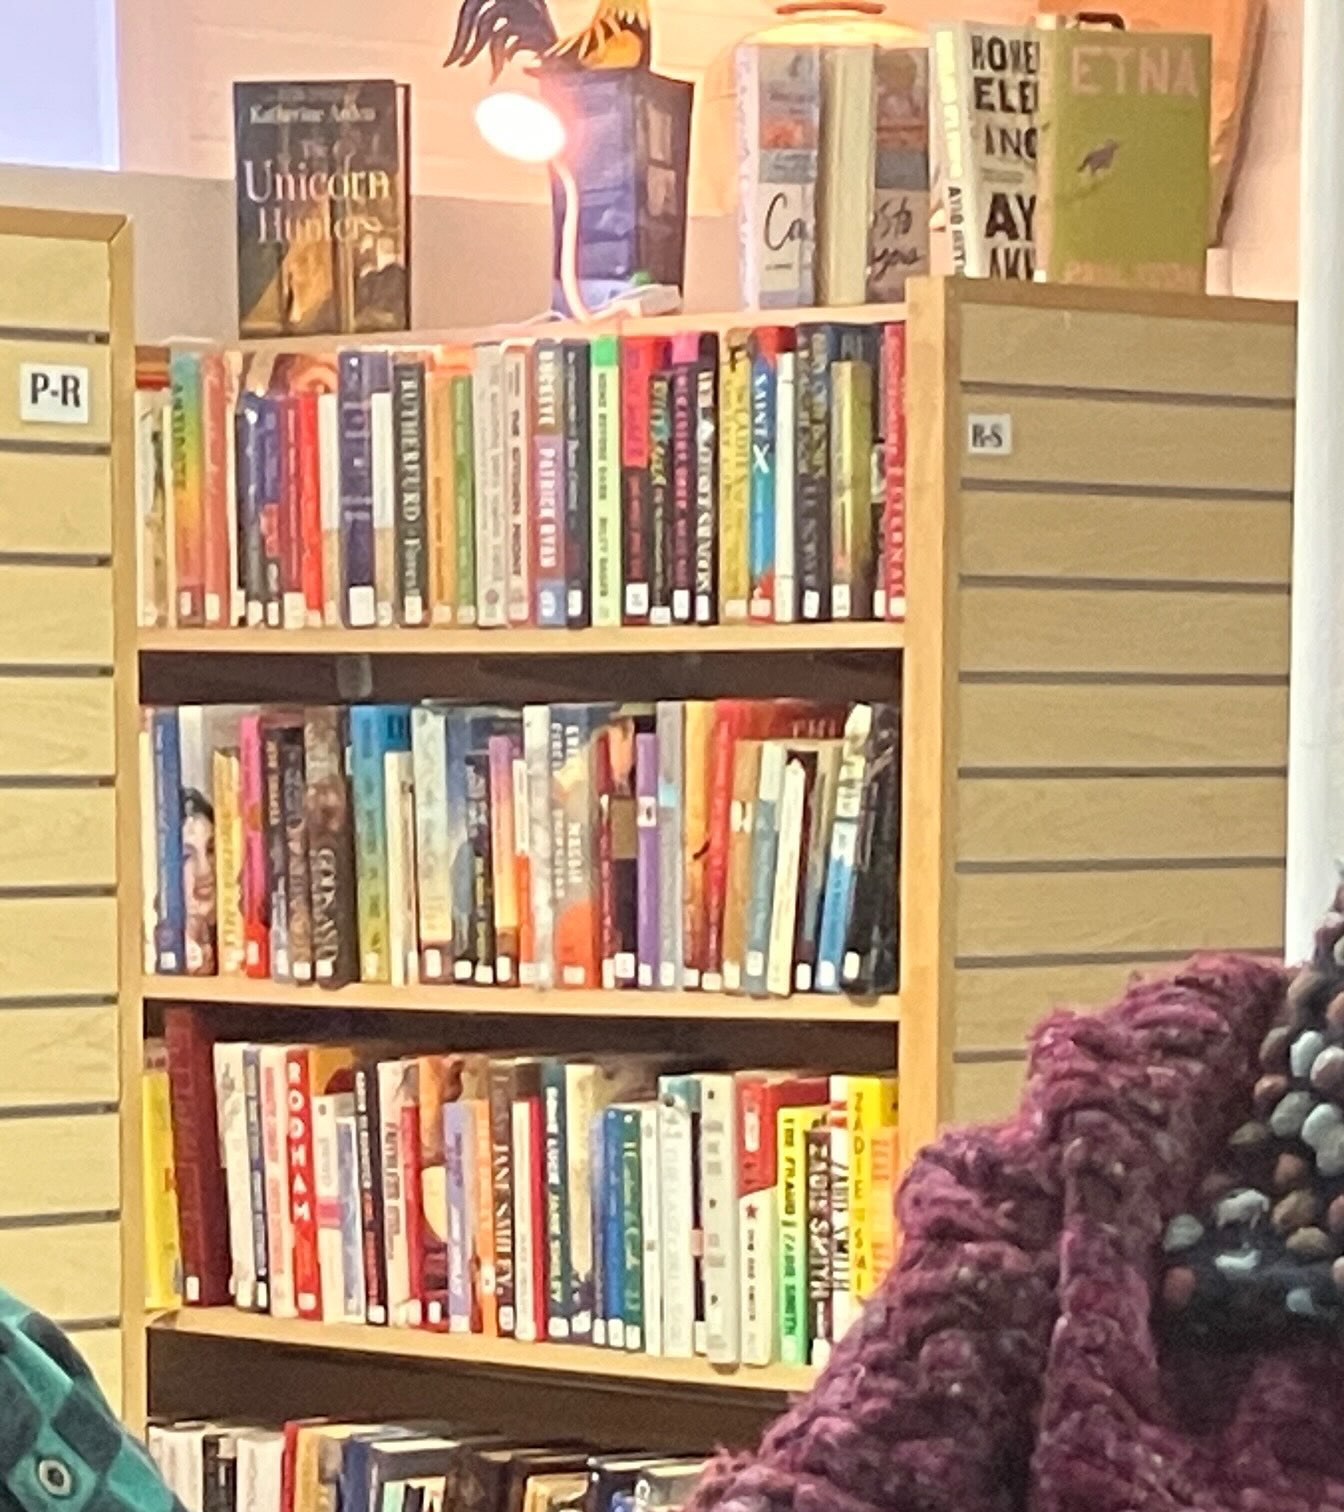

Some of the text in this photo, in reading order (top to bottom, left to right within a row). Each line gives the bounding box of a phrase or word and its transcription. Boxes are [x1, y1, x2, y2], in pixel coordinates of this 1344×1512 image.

[1071, 45, 1200, 99] ETNA
[243, 158, 391, 203] Unicorn
[31, 372, 81, 408] P-R
[752, 374, 768, 437] SAINT
[400, 379, 421, 521] RUTHERFURD
[537, 350, 556, 568] BUCKEYE PATRICK RYAN
[752, 443, 771, 474] X
[972, 423, 1004, 448] R-S
[496, 1143, 511, 1189] JANE
[784, 1157, 795, 1216] FRAUD
[809, 1142, 832, 1299] ZADIE SMITH
[785, 1284, 797, 1336] SMITH
